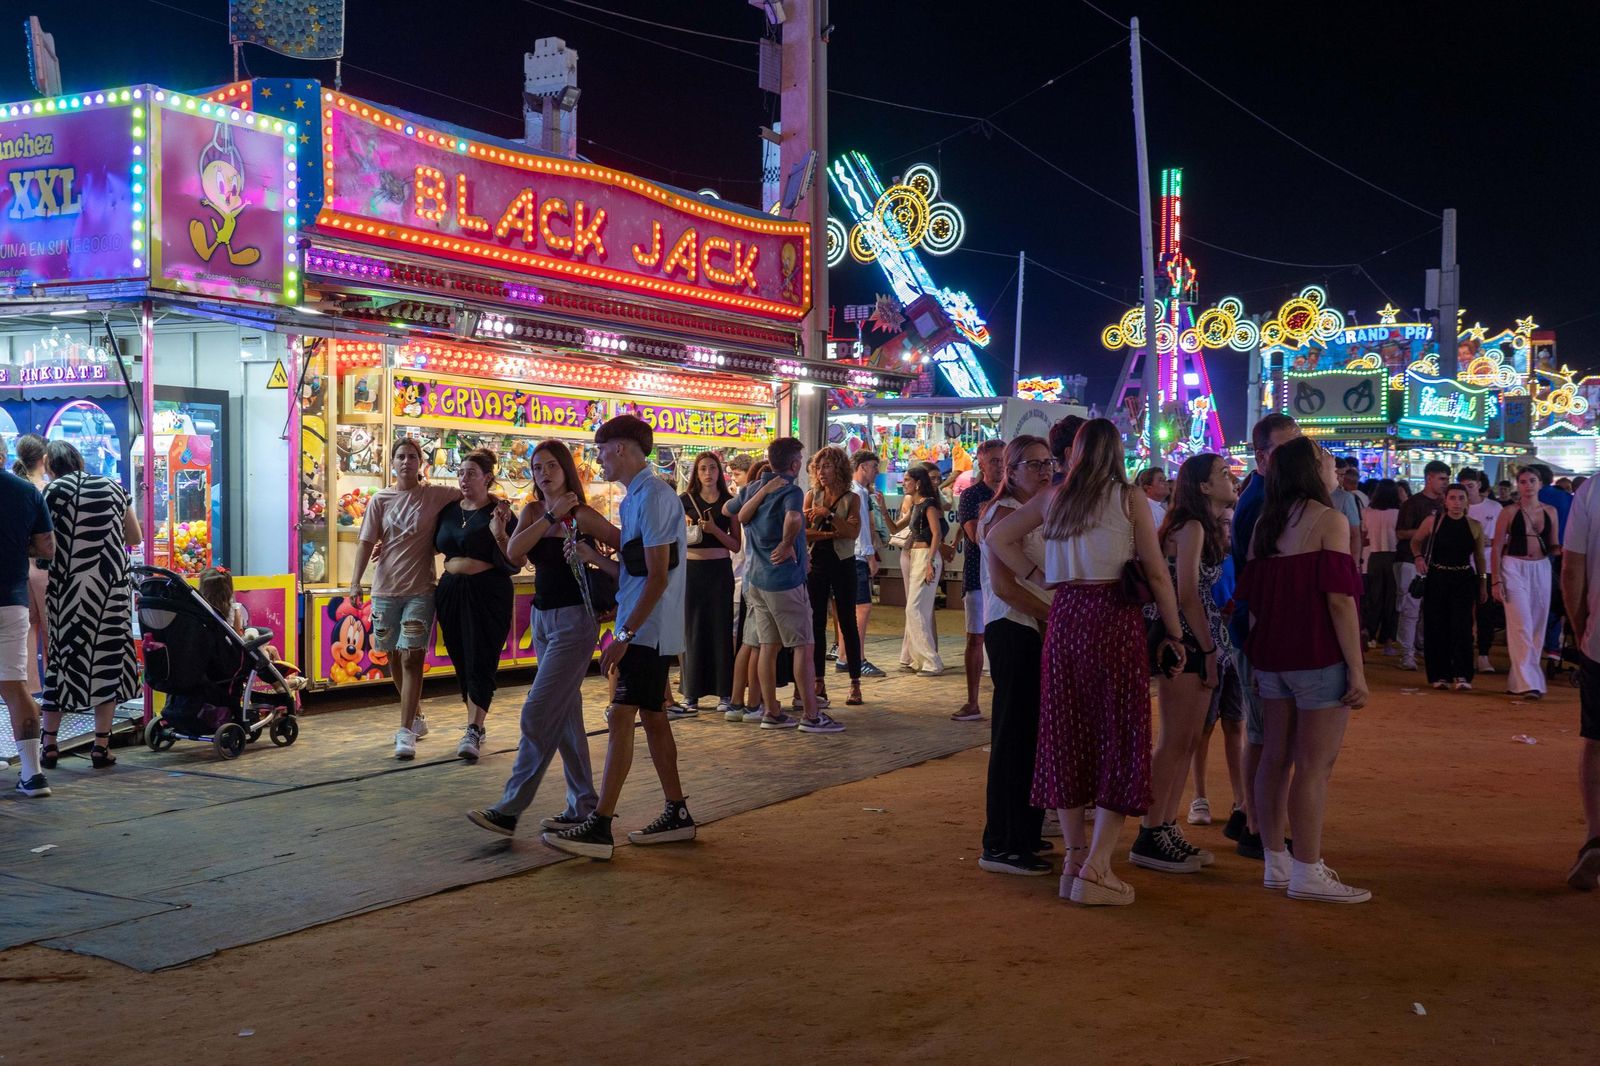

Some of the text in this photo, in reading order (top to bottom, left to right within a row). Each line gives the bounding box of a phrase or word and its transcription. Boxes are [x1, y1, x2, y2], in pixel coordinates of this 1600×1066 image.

[9, 168, 82, 220] XXL
[415, 165, 760, 290] BLACK JACK
[0, 233, 123, 259] UINA EN SU NEGOCIO
[1335, 326, 1434, 345] GRAND PRI
[643, 407, 739, 435] SANCHEZ
